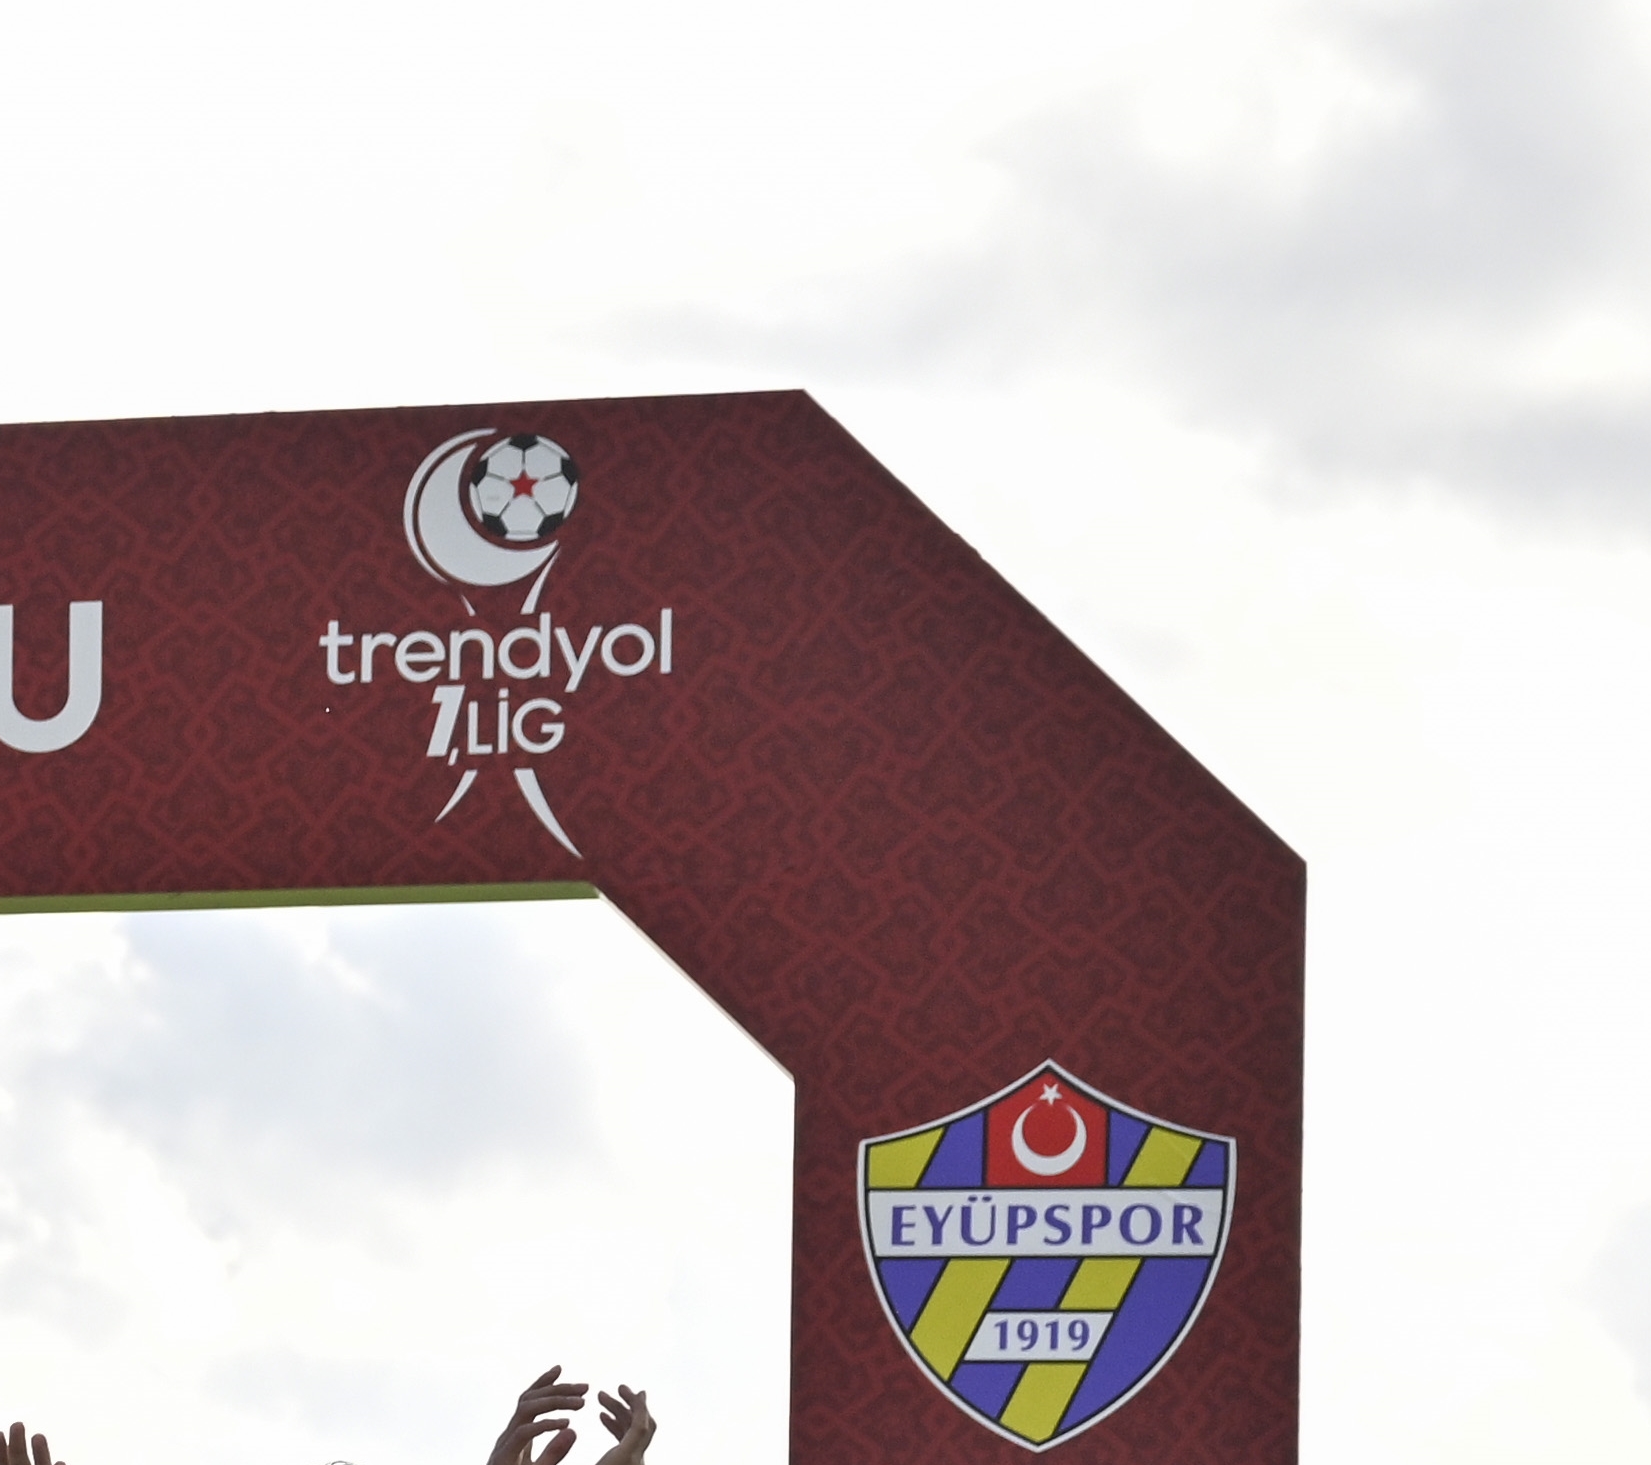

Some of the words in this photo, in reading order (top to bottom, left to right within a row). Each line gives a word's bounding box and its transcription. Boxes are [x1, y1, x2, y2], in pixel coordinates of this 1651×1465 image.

[320, 609, 671, 692] trendyol
[890, 1195, 1207, 1251] EYÜPSPOR
[992, 1317, 1091, 1351] 1919
